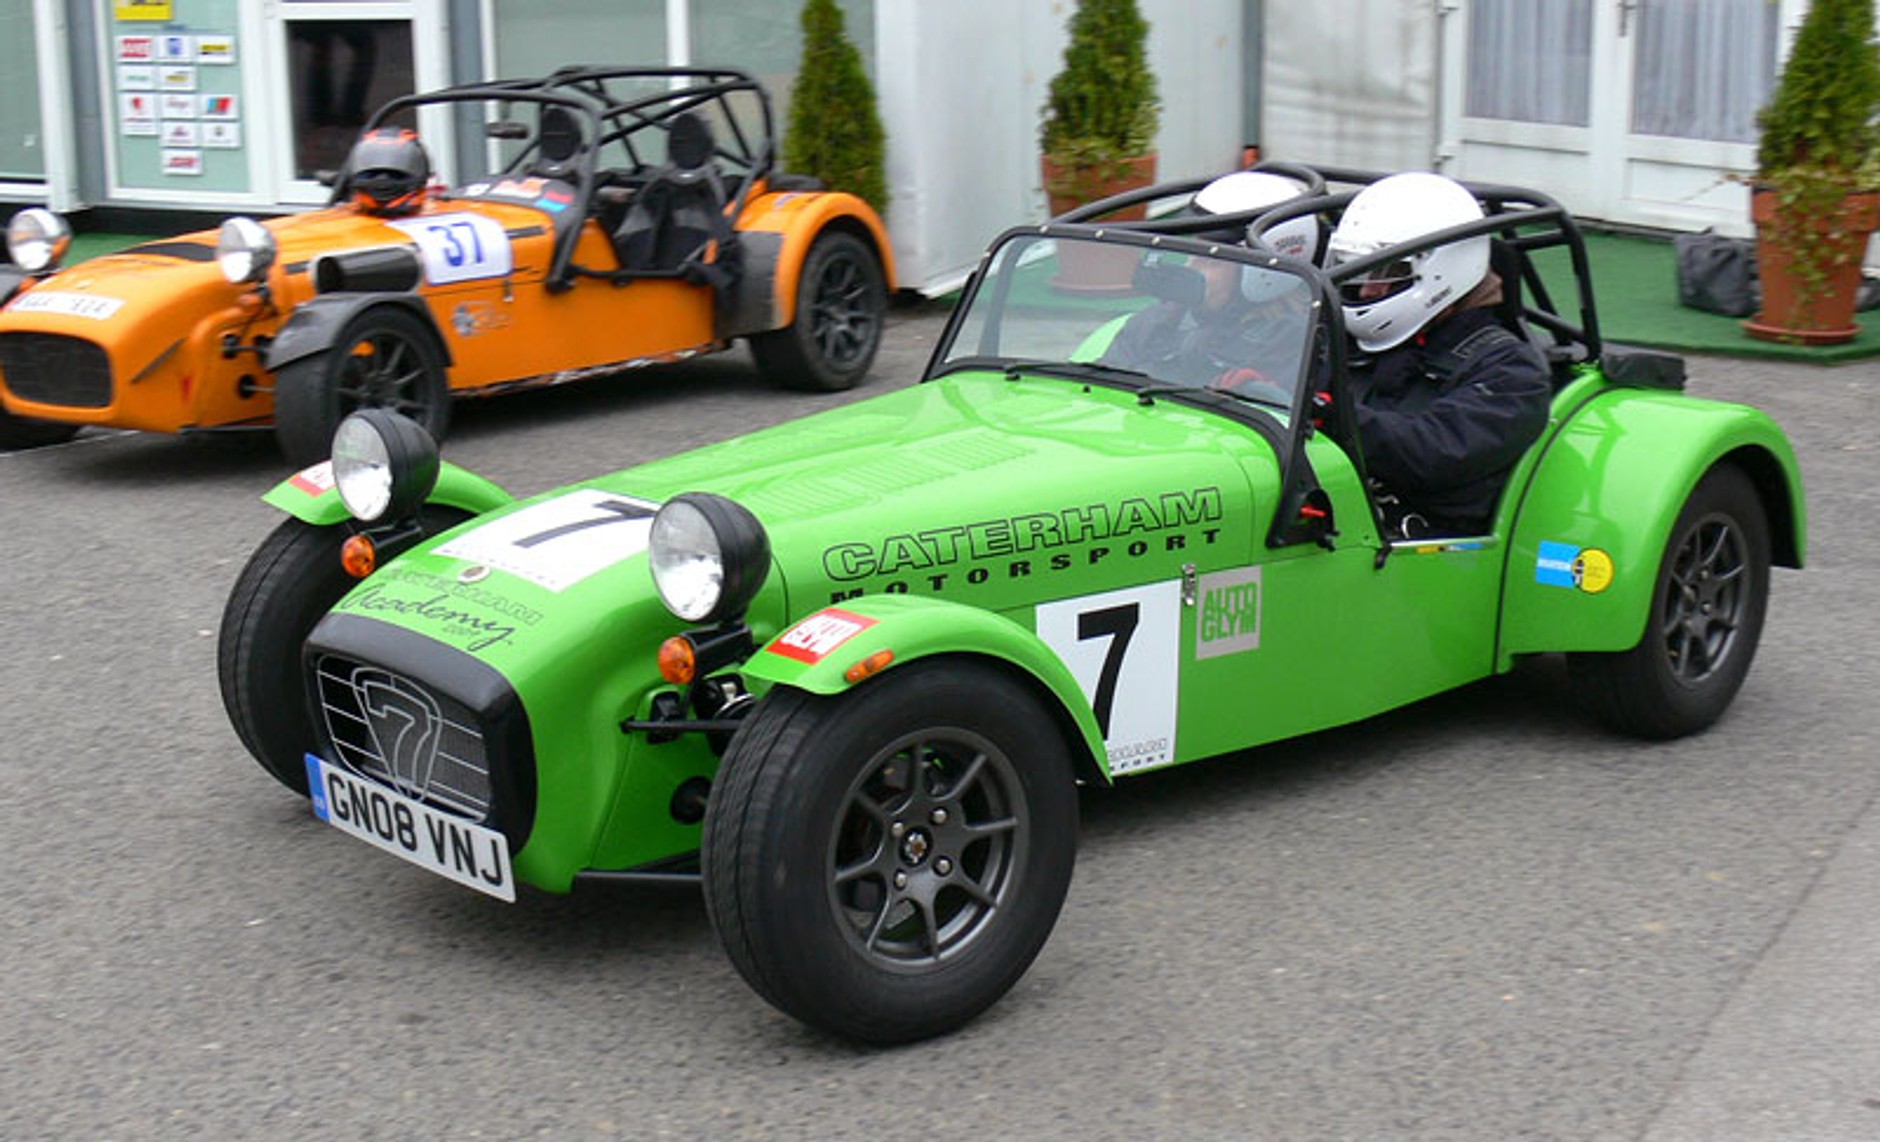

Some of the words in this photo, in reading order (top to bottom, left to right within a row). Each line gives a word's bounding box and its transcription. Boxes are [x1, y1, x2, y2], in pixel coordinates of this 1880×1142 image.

[427, 220, 483, 267] 37
[823, 486, 1223, 582] CATERHAM
[1077, 602, 1140, 741] 7
[328, 772, 418, 852] GN08
[425, 811, 504, 887] VNJ
